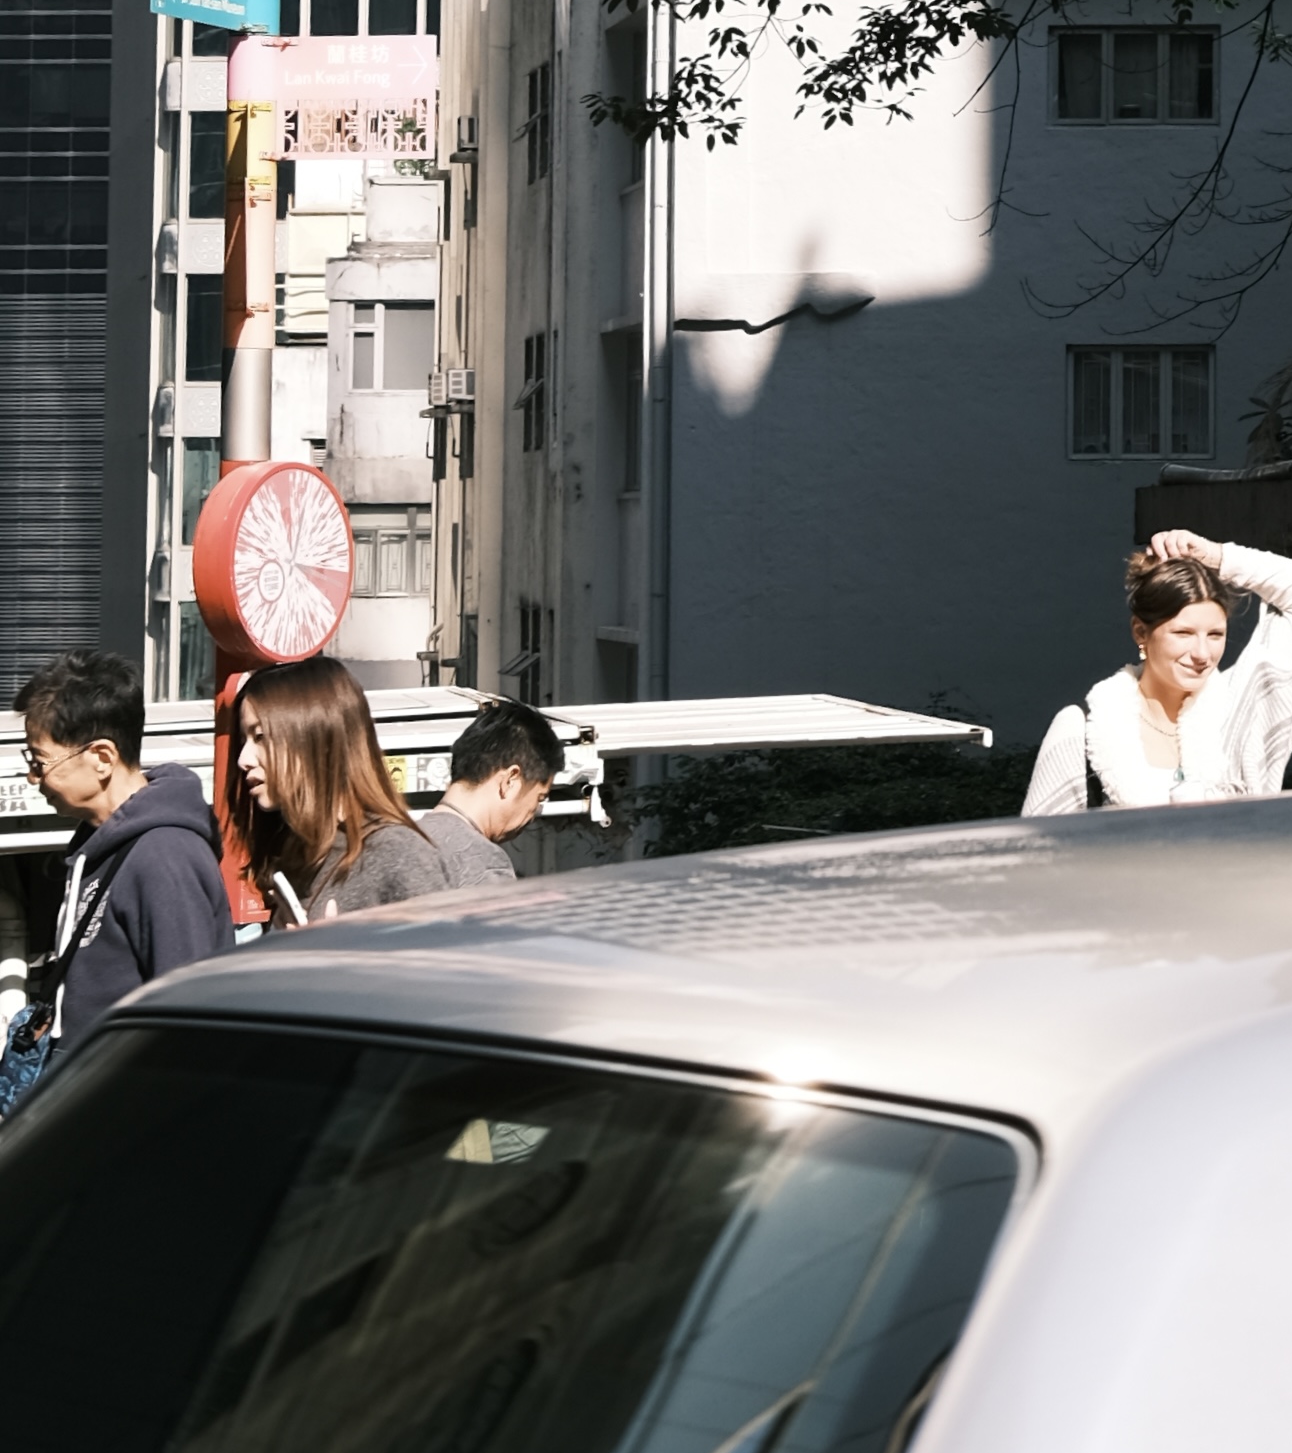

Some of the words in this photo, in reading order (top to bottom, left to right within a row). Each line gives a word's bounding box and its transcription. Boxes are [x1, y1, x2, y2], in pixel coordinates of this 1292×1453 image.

[327, 44, 390, 65] 蘭桂坊
[284, 70, 312, 86] Lan
[315, 69, 350, 86] Kwai
[354, 69, 391, 88] Fong
